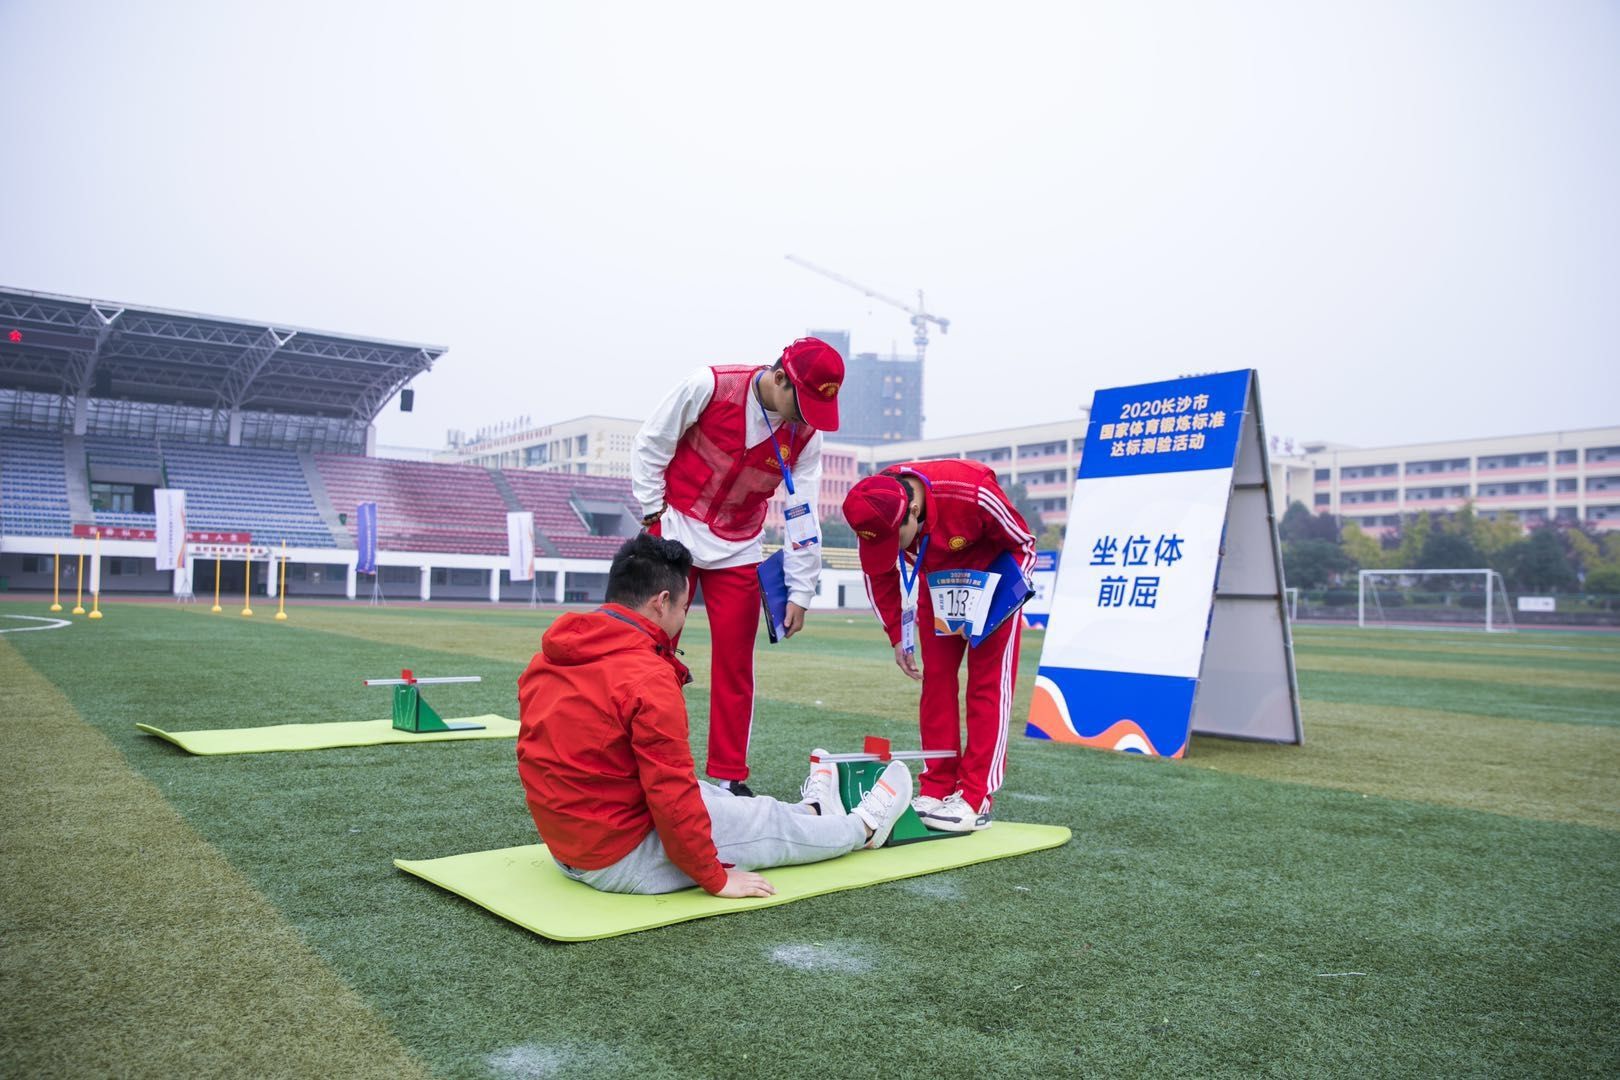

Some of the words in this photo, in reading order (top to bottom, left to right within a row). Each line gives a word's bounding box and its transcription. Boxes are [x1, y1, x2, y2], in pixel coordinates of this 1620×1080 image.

[1120, 394, 1209, 419] 2020长沙市
[1099, 410, 1226, 440] 国家体育锻炼标准
[1110, 432, 1205, 457] 达标测验活动
[1090, 533, 1184, 567] 坐位体
[1097, 575, 1160, 608] 前屈
